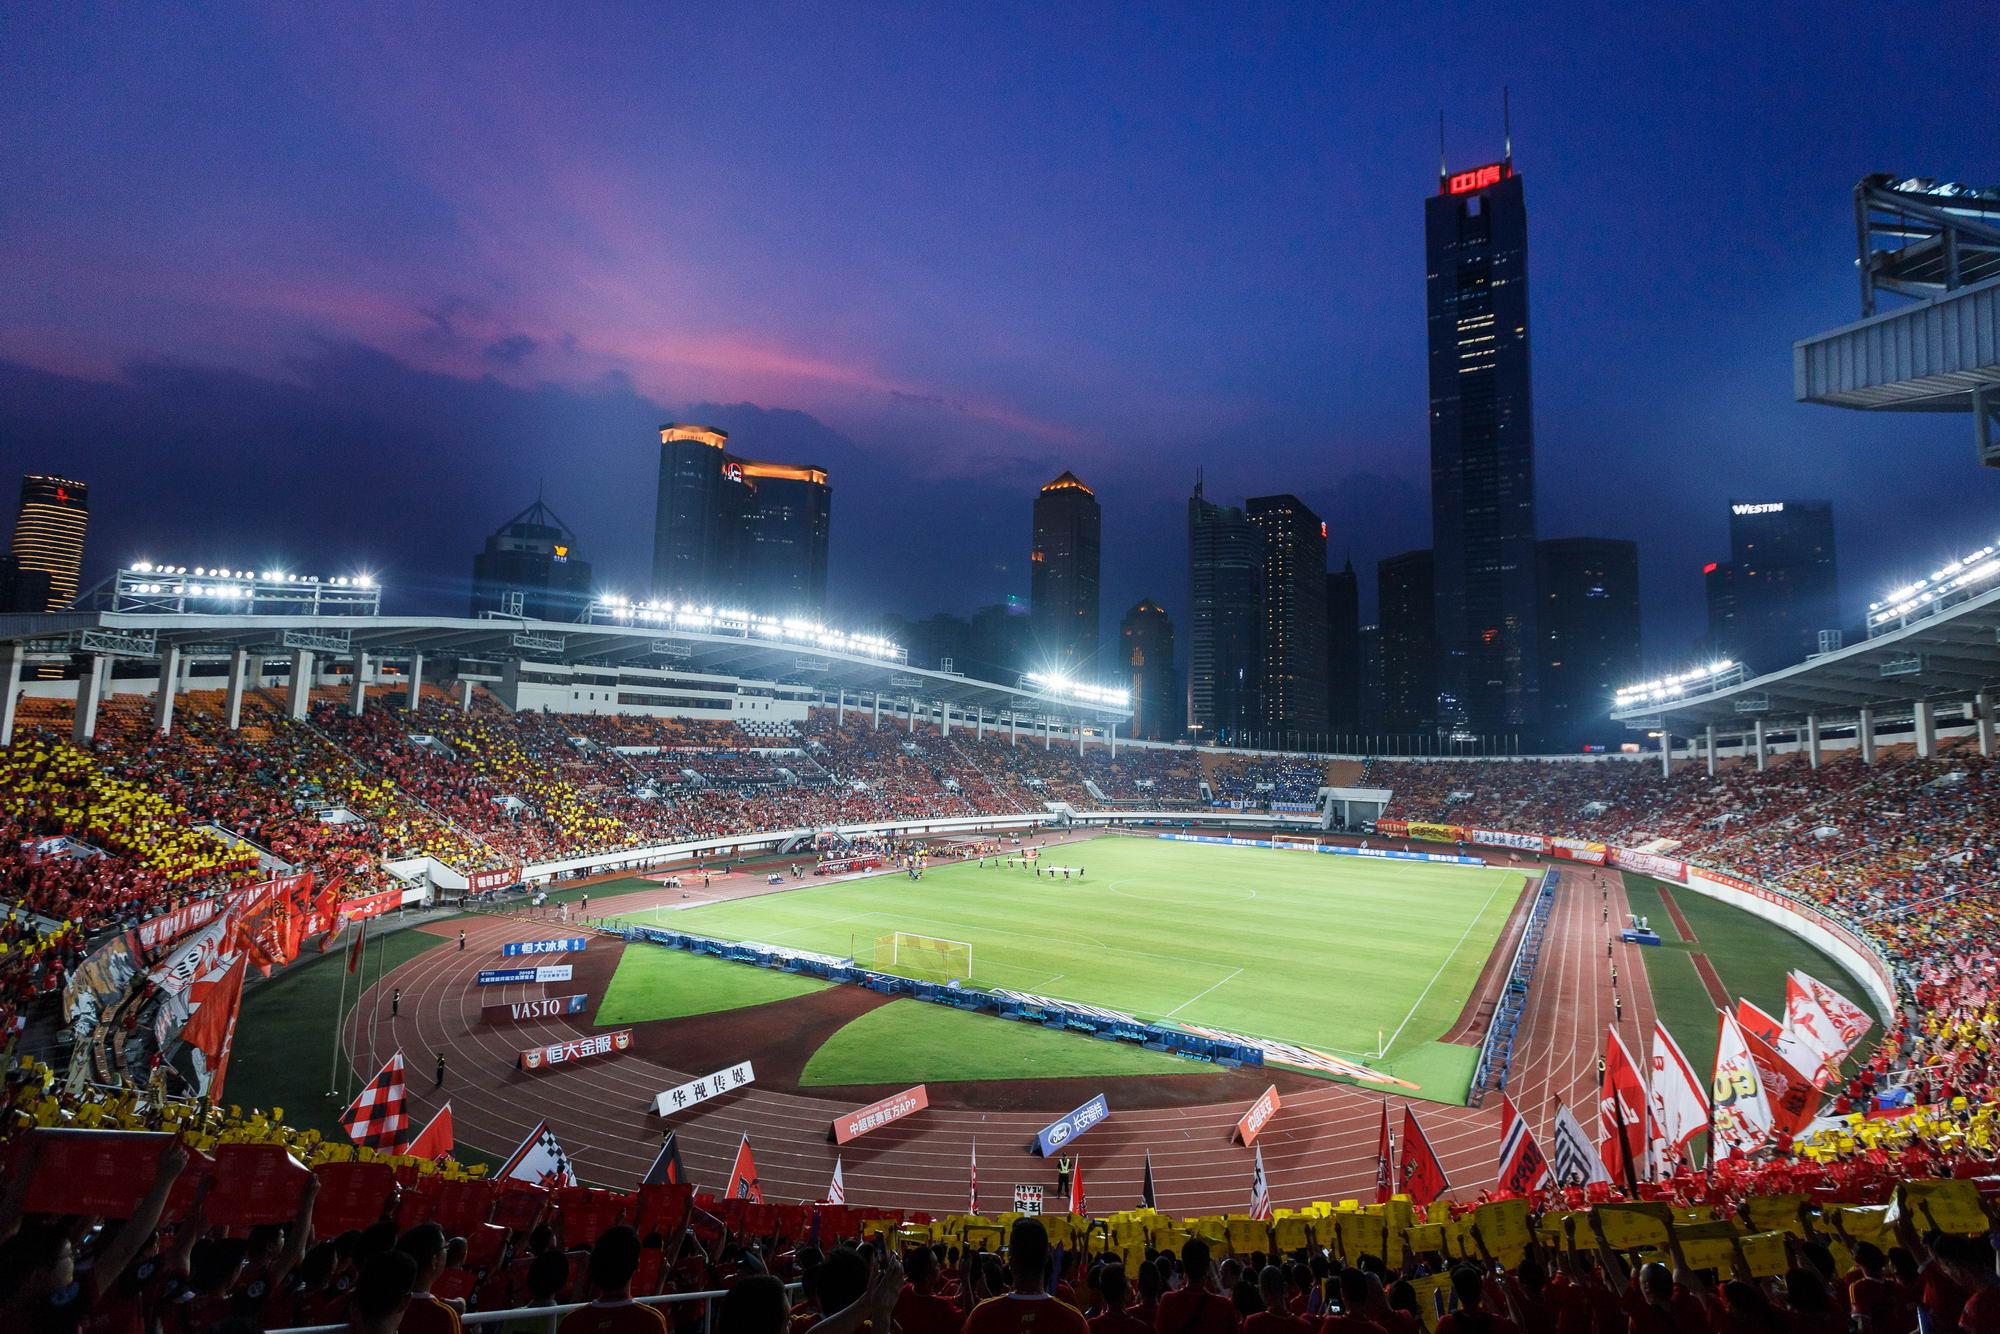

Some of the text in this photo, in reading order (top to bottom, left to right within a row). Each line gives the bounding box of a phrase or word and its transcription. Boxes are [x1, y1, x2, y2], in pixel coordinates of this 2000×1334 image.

[1450, 165, 1500, 194] 中信
[1732, 502, 1783, 515] WESTIN
[190, 901, 214, 926] TEAM
[521, 940, 568, 954] 恒大冰泉
[511, 1000, 560, 1019] VASTO
[546, 1035, 612, 1064] 恒大金服
[672, 1067, 746, 1108] 华视传媒
[1073, 1101, 1103, 1131] 长安福特
